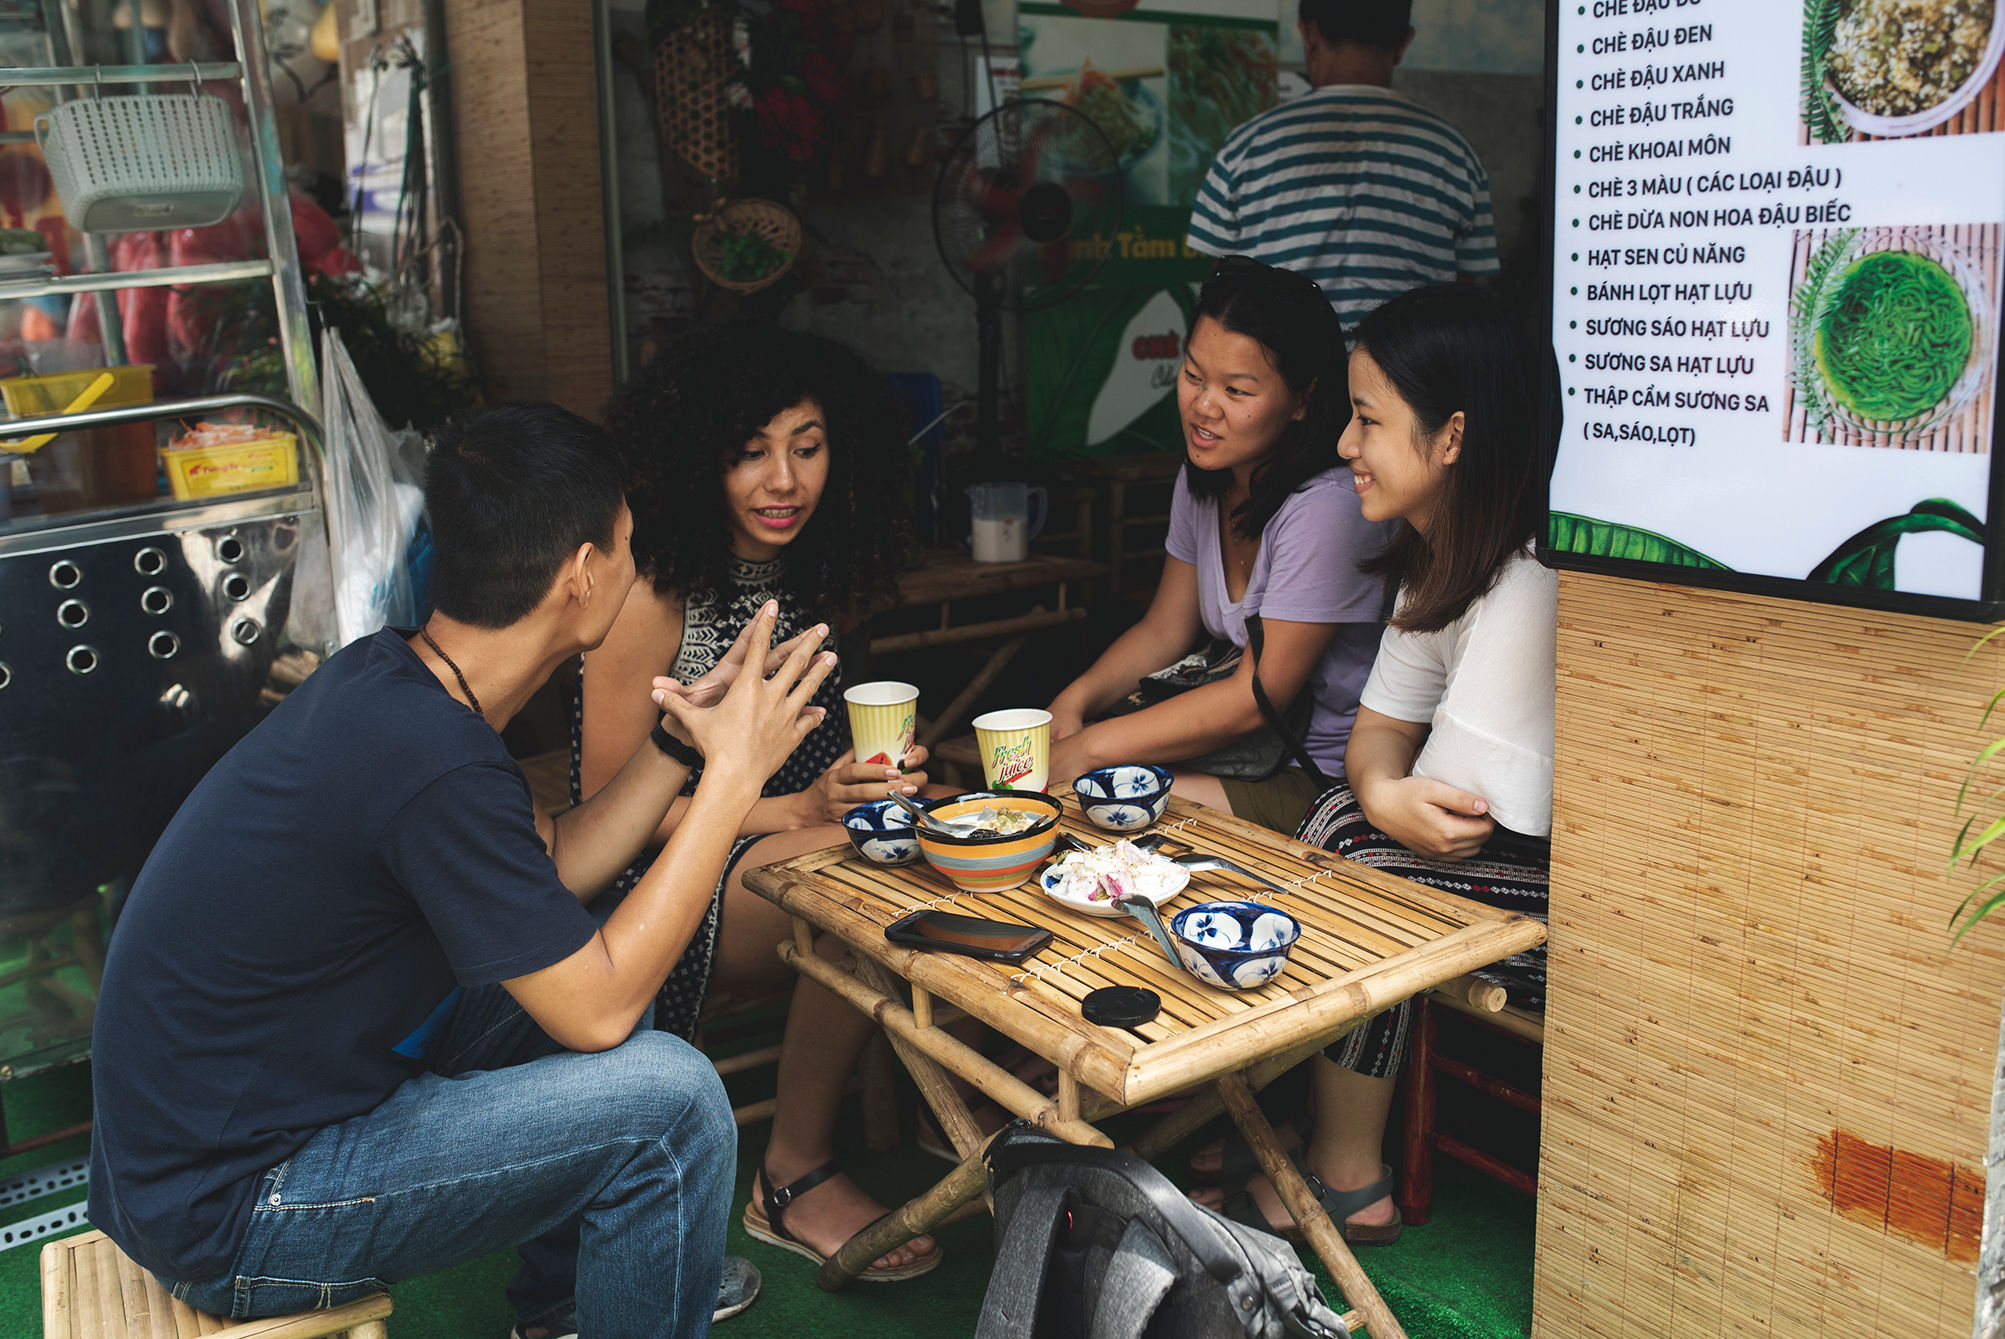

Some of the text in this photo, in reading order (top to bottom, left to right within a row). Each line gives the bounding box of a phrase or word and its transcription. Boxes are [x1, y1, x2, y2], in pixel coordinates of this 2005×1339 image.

[1592, 24, 1712, 55] CHÈ ĐẬU ĐEN
[1591, 61, 1724, 91] CHÈ ĐẬU XANH
[1590, 94, 1733, 127] CHÈ ĐẬU TRẮNG
[1589, 134, 1730, 162] CHÈ KHOAI MÔN
[1589, 177, 1622, 198] CHÈ
[1627, 180, 1637, 196] 3
[1642, 174, 1681, 195] MÀU
[1740, 172, 1781, 193] LOẠI
[1589, 198, 1851, 231] CHÈ DỪA NON HOA ĐẬU BIẾC
[1588, 243, 1745, 269] HẠT SEN CỦ NĂNG
[1588, 281, 1752, 305] BÁNH LỌT HẠT LỰU
[1586, 316, 1769, 341] SƯƠNG SÁO HẠT LỰU
[1585, 352, 1754, 378] SƯƠNG SA HẠT LỰU
[1584, 384, 1769, 412] THẬP CẨM SƯƠNG SA
[991, 735, 1032, 769] Fresh
[997, 755, 1034, 784] juice
